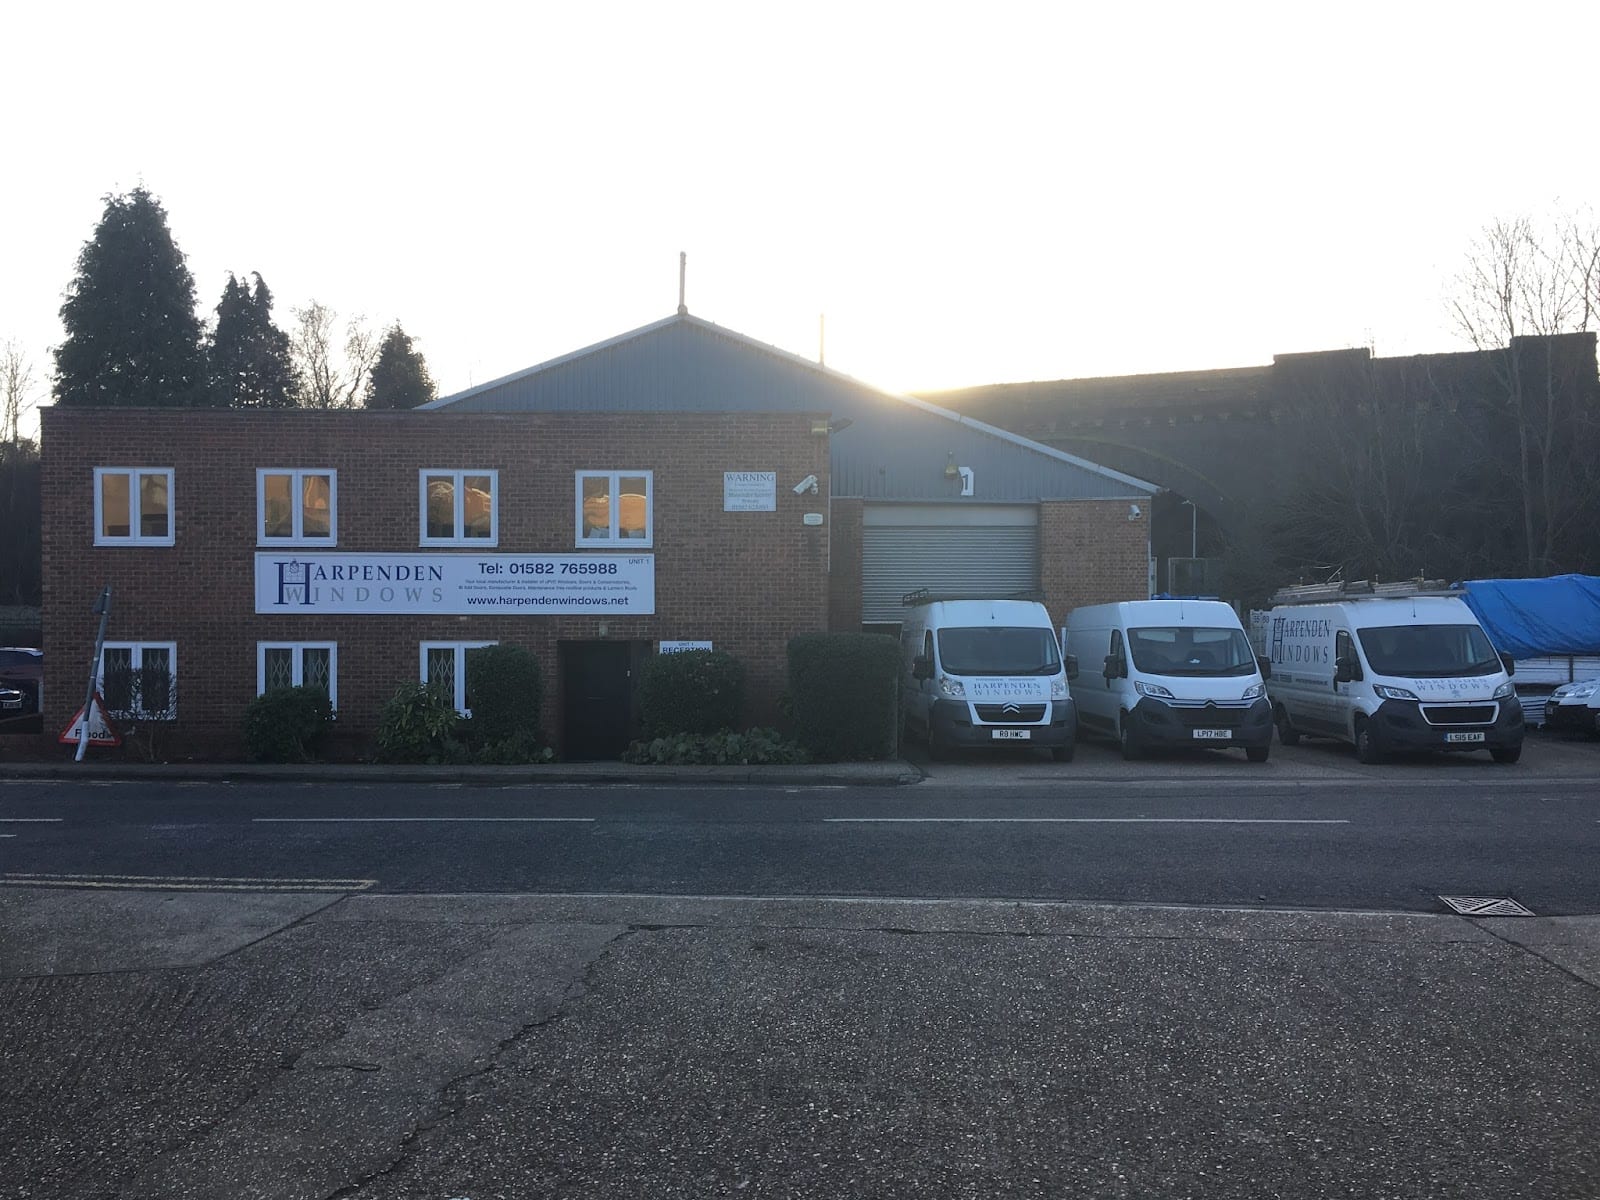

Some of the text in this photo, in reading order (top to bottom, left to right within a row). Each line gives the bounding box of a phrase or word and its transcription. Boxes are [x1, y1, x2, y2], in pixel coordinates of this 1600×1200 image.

[726, 473, 774, 481] WARNING
[478, 562, 618, 575] Tel: 01582 765988
[273, 561, 443, 605] HARPENDEN
[285, 587, 443, 602] WINDOWS
[467, 596, 629, 607] www.harpendenwindows.net
[1274, 644, 1328, 663] WINDOWS
[974, 689, 1042, 697] WINDOWS
[1416, 683, 1490, 692] WINDOWS
[75, 728, 105, 739] Fod
